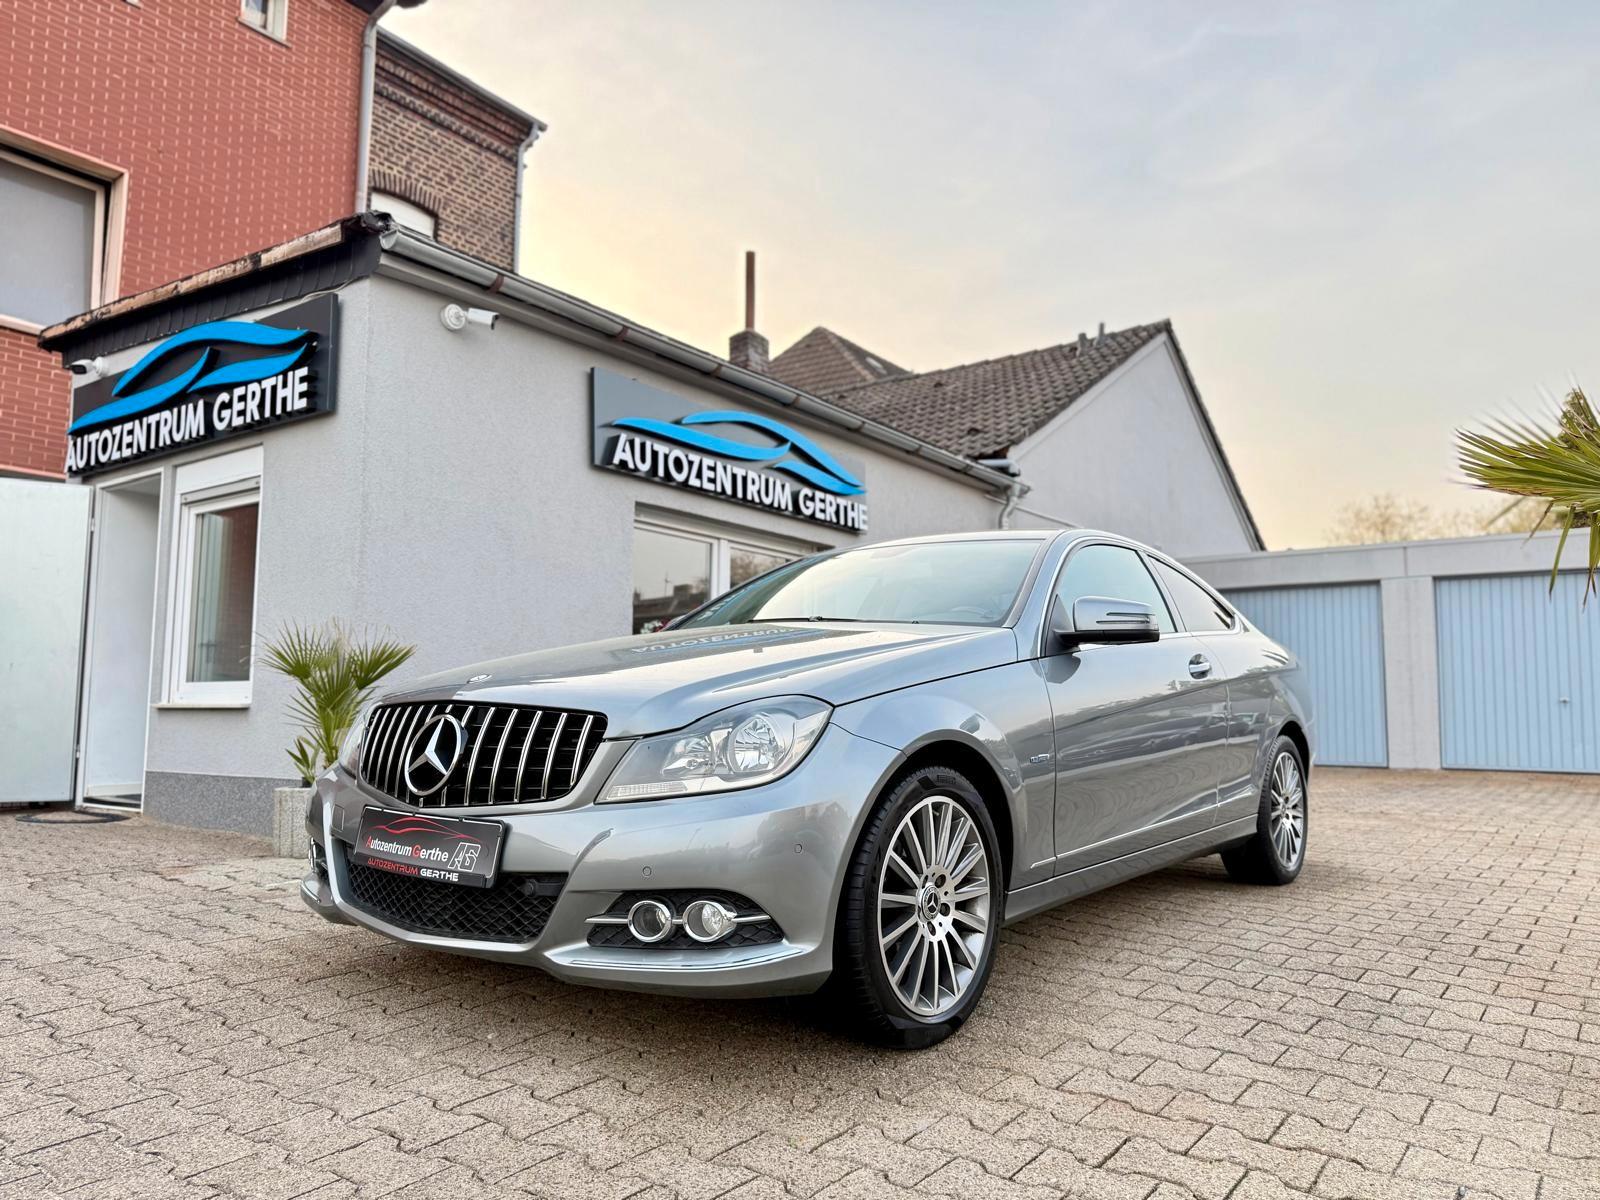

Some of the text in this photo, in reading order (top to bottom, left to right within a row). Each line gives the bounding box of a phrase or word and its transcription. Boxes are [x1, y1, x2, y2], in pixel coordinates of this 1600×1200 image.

[65, 367, 308, 472] AUTOZENTRUM GERTHE
[613, 433, 869, 531] AUTOZENTRUM GERTHE
[367, 858, 459, 881] AUTOZENTRUM GERTHE
